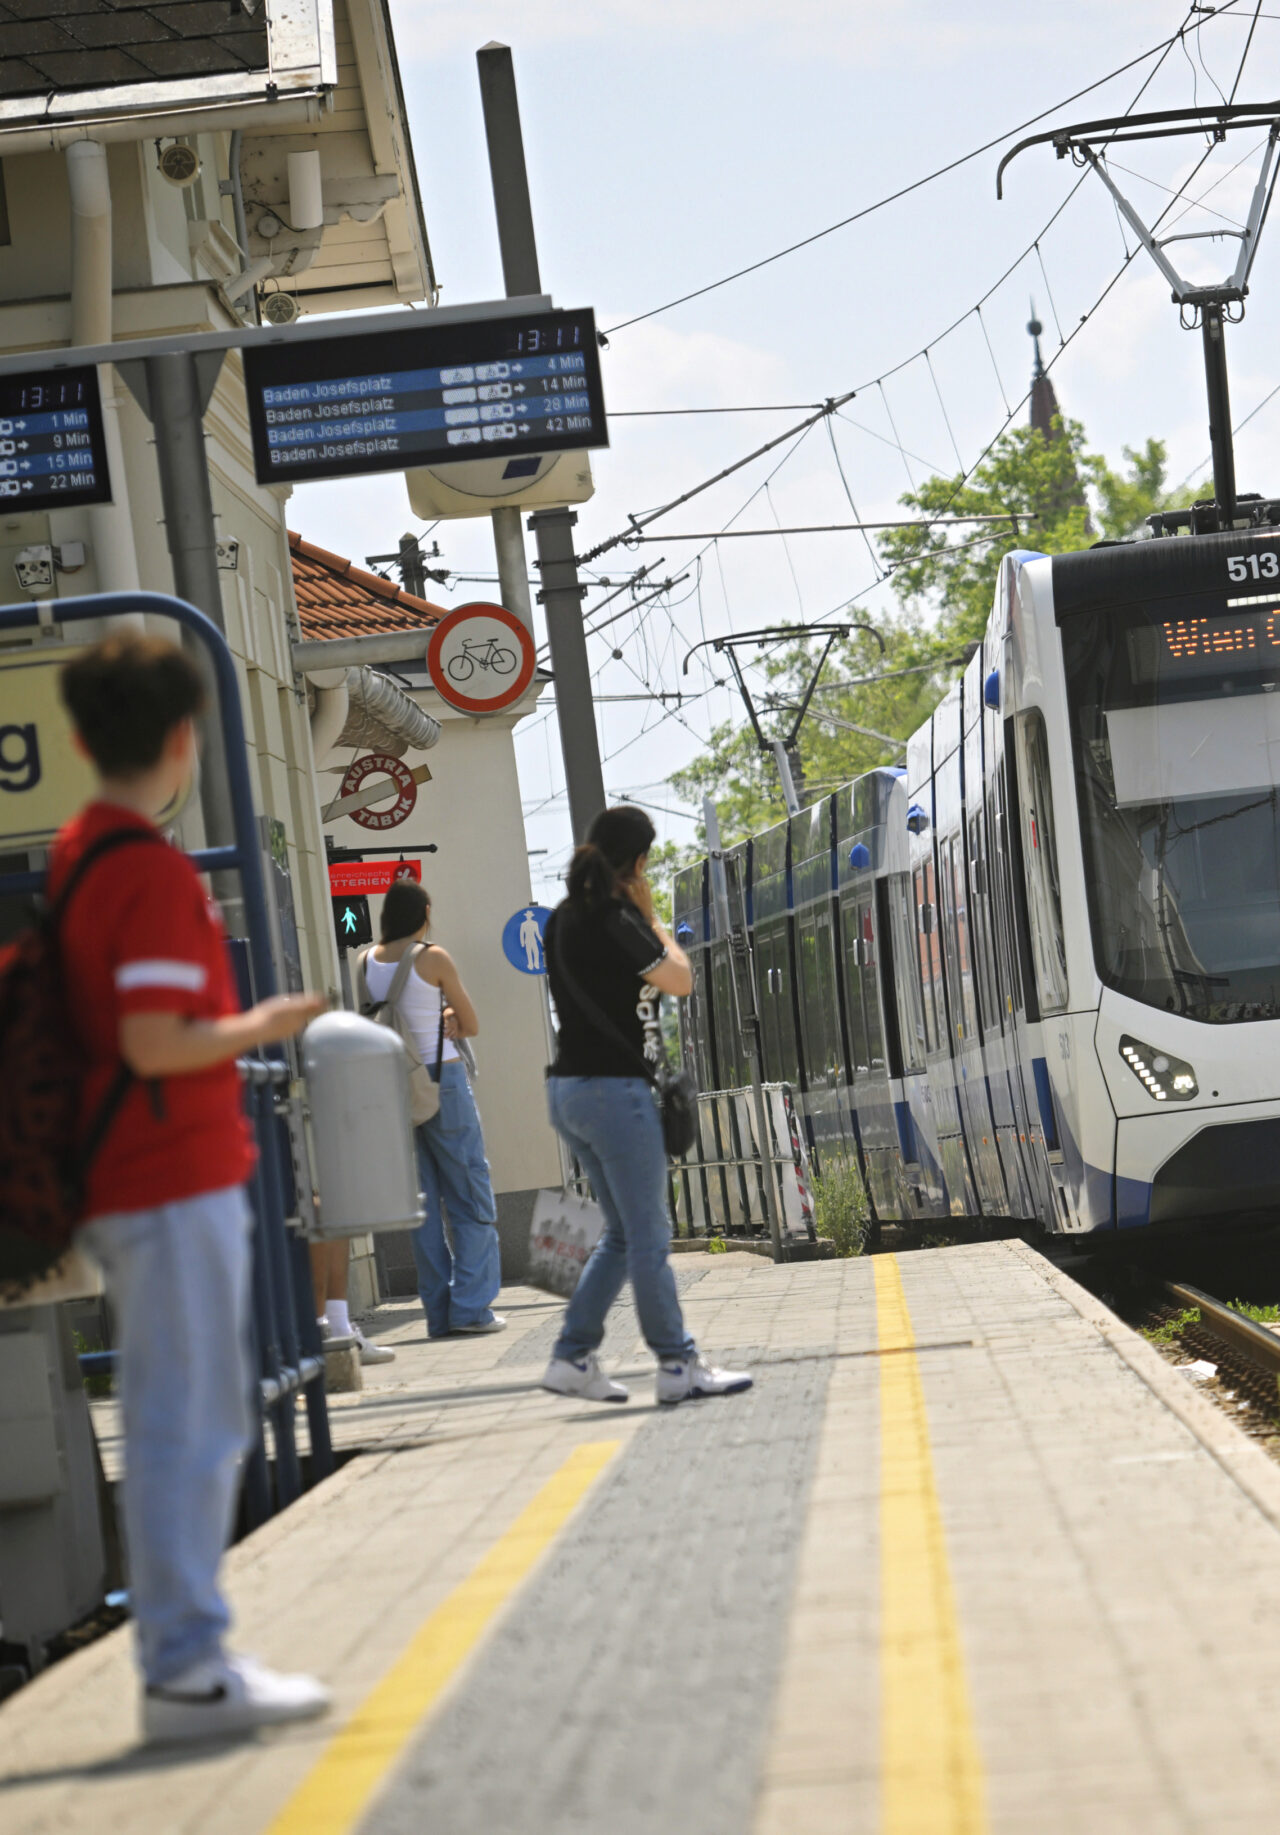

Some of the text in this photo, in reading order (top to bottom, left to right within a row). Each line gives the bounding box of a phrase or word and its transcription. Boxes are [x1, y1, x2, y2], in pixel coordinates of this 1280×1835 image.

[518, 326, 579, 351] 13:11
[548, 356, 585, 371] 4 Min
[21, 383, 82, 408] 13:11
[264, 376, 392, 403] Baden Josefsplatz
[542, 376, 587, 392] 14 Min
[266, 396, 395, 424] Baden Josefsplatz
[544, 396, 589, 413] 28 Min
[52, 413, 88, 428] 1 Min
[268, 417, 397, 443] Baden Josefsplatz
[546, 416, 591, 432] 42 Min
[54, 432, 90, 449] 9 Min
[270, 436, 399, 463] Baden Josefsplatz
[47, 453, 92, 469] 15 Min
[49, 472, 95, 489] 22 Min
[1227, 552, 1279, 582] 513
[1163, 617, 1255, 657] Wien
[344, 757, 412, 793] AUSTRIA
[358, 797, 413, 827] TABAK
